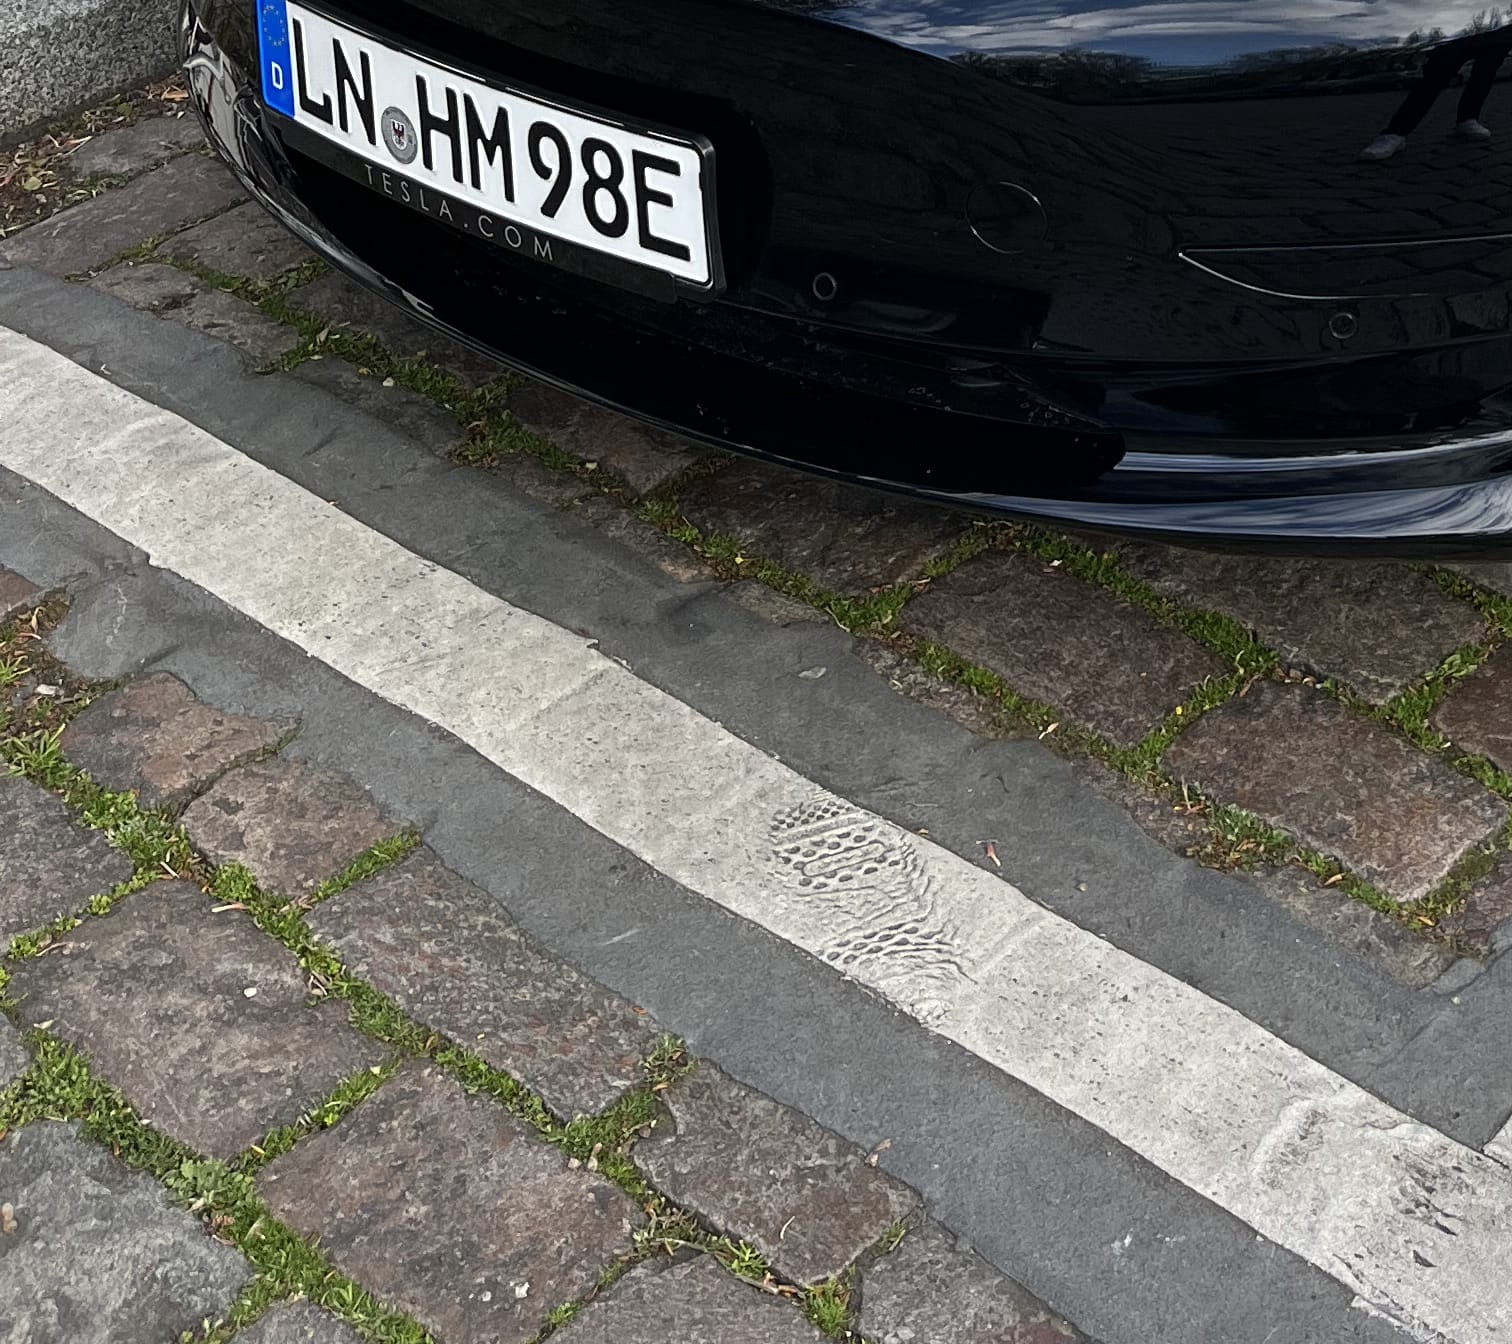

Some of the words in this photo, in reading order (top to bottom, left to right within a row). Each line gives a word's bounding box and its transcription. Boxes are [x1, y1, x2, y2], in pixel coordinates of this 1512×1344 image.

[271, 61, 284, 90] D
[292, 17, 377, 147] LN
[415, 74, 516, 204] HM
[527, 119, 692, 263] 98E
[365, 164, 553, 261] TESLA.COM
